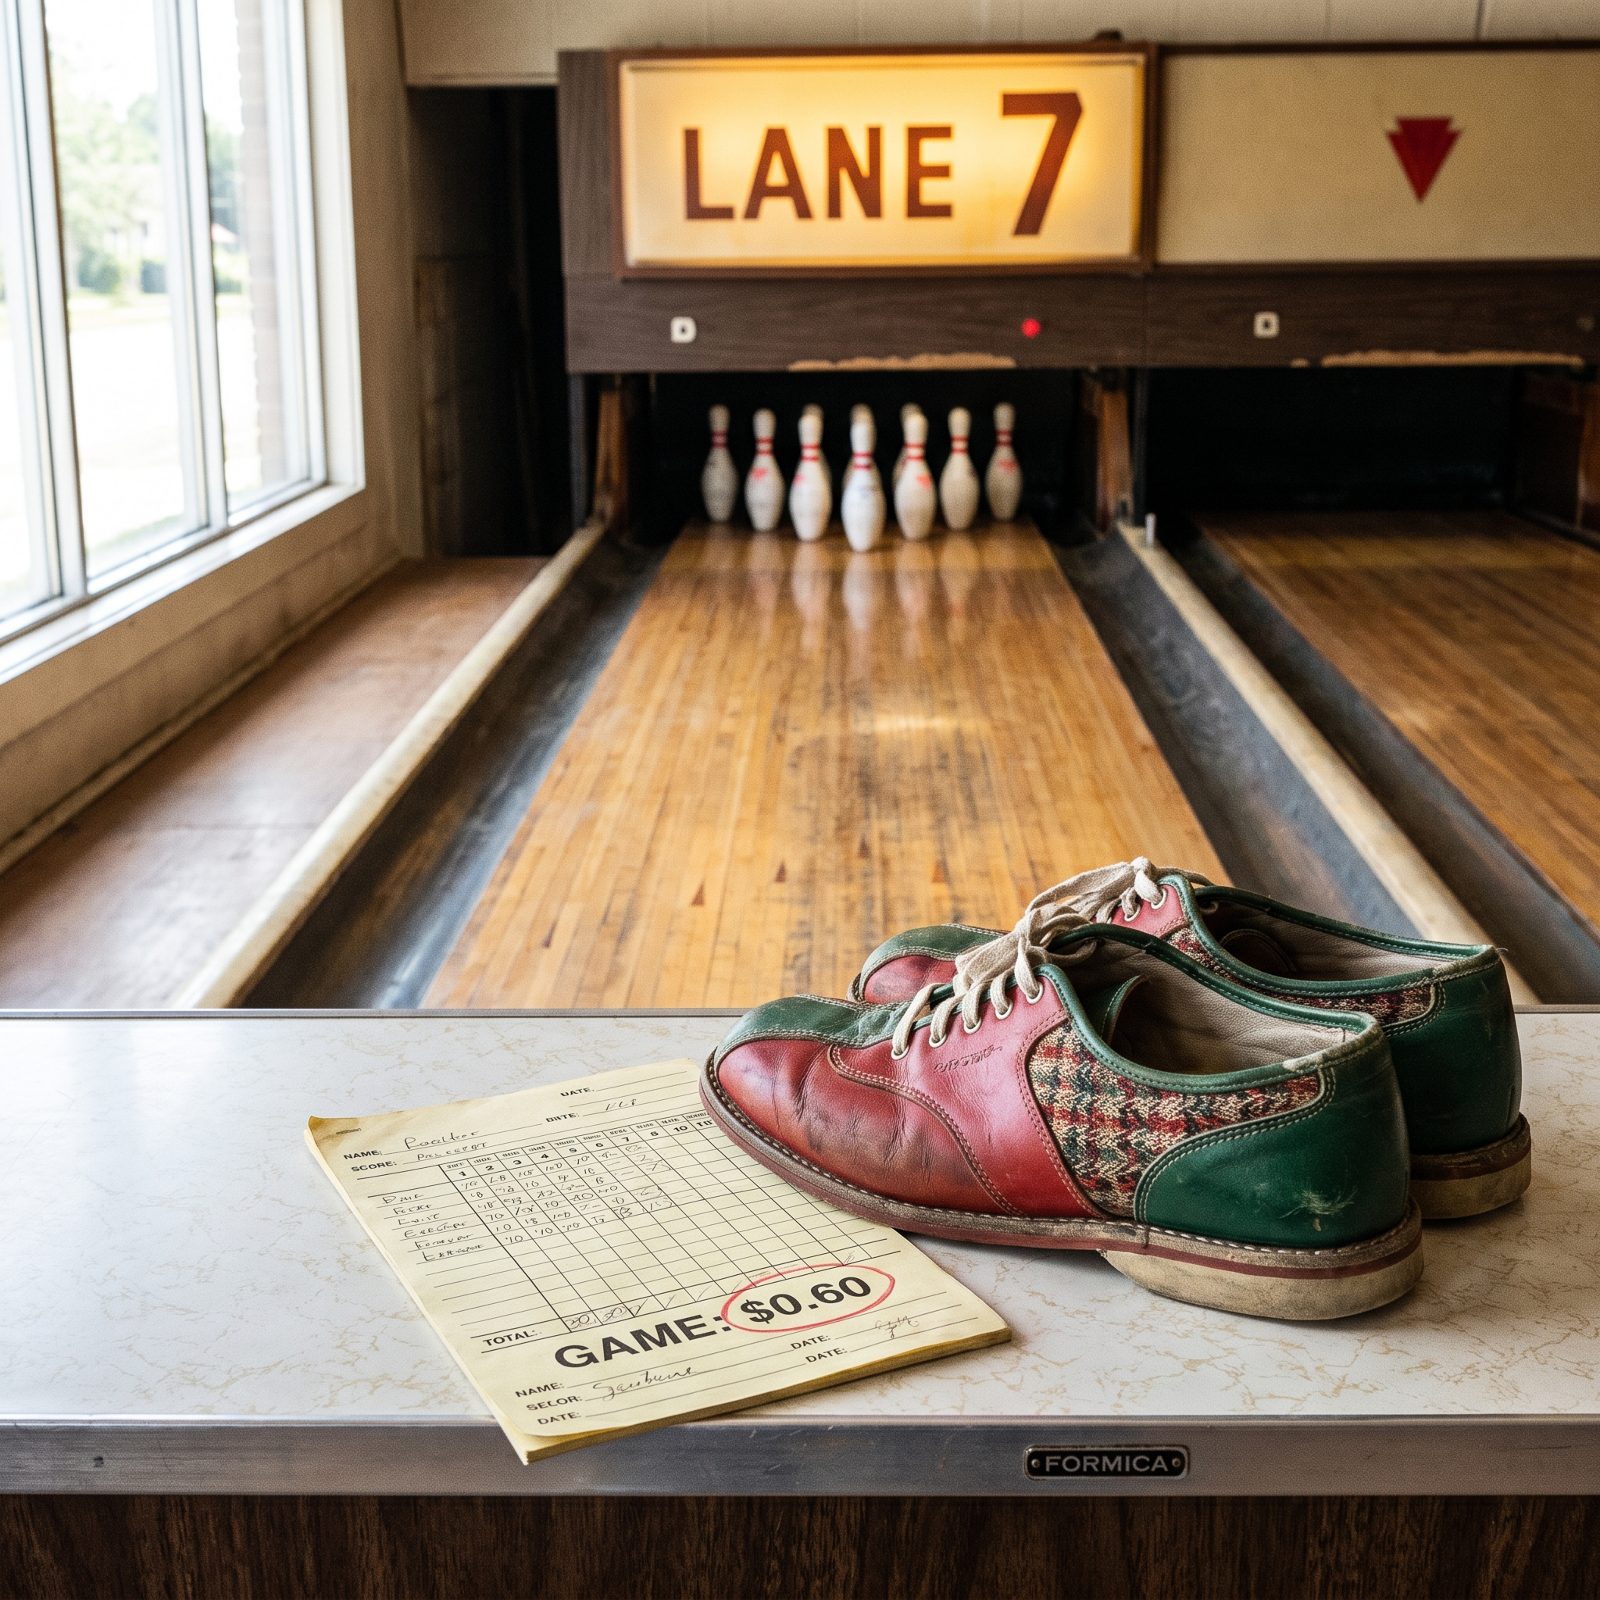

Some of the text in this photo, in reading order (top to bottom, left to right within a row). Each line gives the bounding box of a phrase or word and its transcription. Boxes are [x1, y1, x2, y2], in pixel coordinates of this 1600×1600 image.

[684, 91, 1083, 237] LANE 7
[343, 1149, 383, 1160] NAME:
[351, 1160, 397, 1172] SCORE:
[740, 1276, 872, 1325] $0.60
[482, 1328, 540, 1347] TOTAL:
[554, 1314, 732, 1368] GAME:
[790, 1334, 831, 1350] DATE:
[805, 1346, 848, 1364] DATE:
[515, 1381, 564, 1398] NAME:
[537, 1410, 581, 1426] DATE:
[1044, 1455, 1169, 1473] FORMICA
